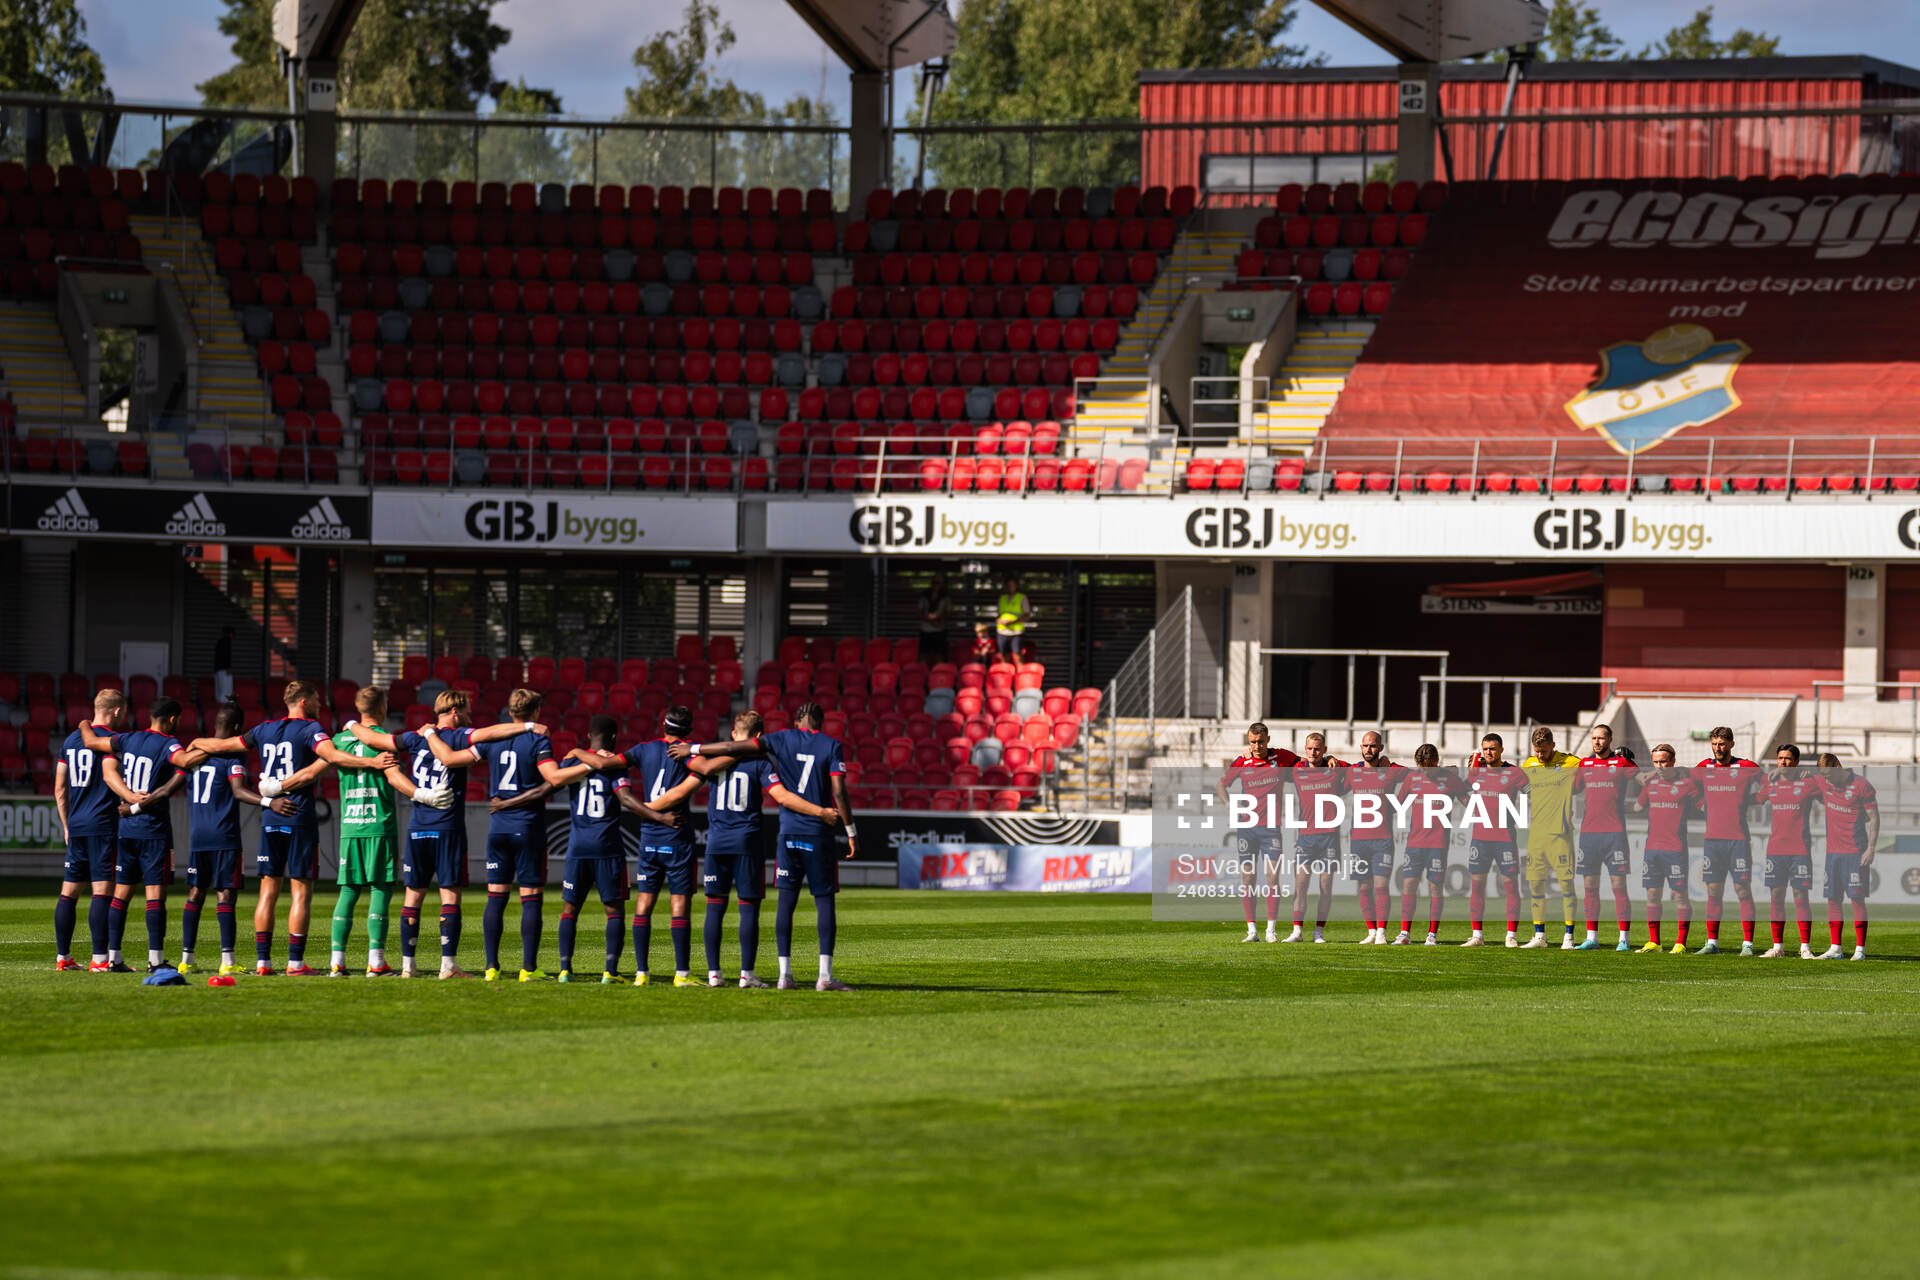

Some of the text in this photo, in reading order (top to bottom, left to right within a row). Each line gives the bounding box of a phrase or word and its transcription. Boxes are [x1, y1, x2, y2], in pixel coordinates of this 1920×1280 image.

[1523, 274, 1920, 296] Stolt samarbetspartner
[1669, 301, 1747, 318] med
[38, 515, 99, 532] adidas
[165, 519, 227, 537] adidas
[291, 523, 351, 540] adidas
[465, 500, 645, 544] GBJ bygg.
[850, 505, 1016, 547] GBJ bygg.
[1185, 507, 1357, 549] GBJ bygg.
[1534, 508, 1712, 551] GBJ bygg.
[124, 752, 153, 793] 30
[263, 741, 293, 782] 23
[499, 750, 517, 791] 2
[796, 753, 815, 794] 7
[192, 765, 216, 804] 17
[576, 778, 605, 818] 16
[715, 770, 749, 812] 10
[1301, 782, 1331, 791] EMILSHUS
[888, 829, 966, 847] stadium
